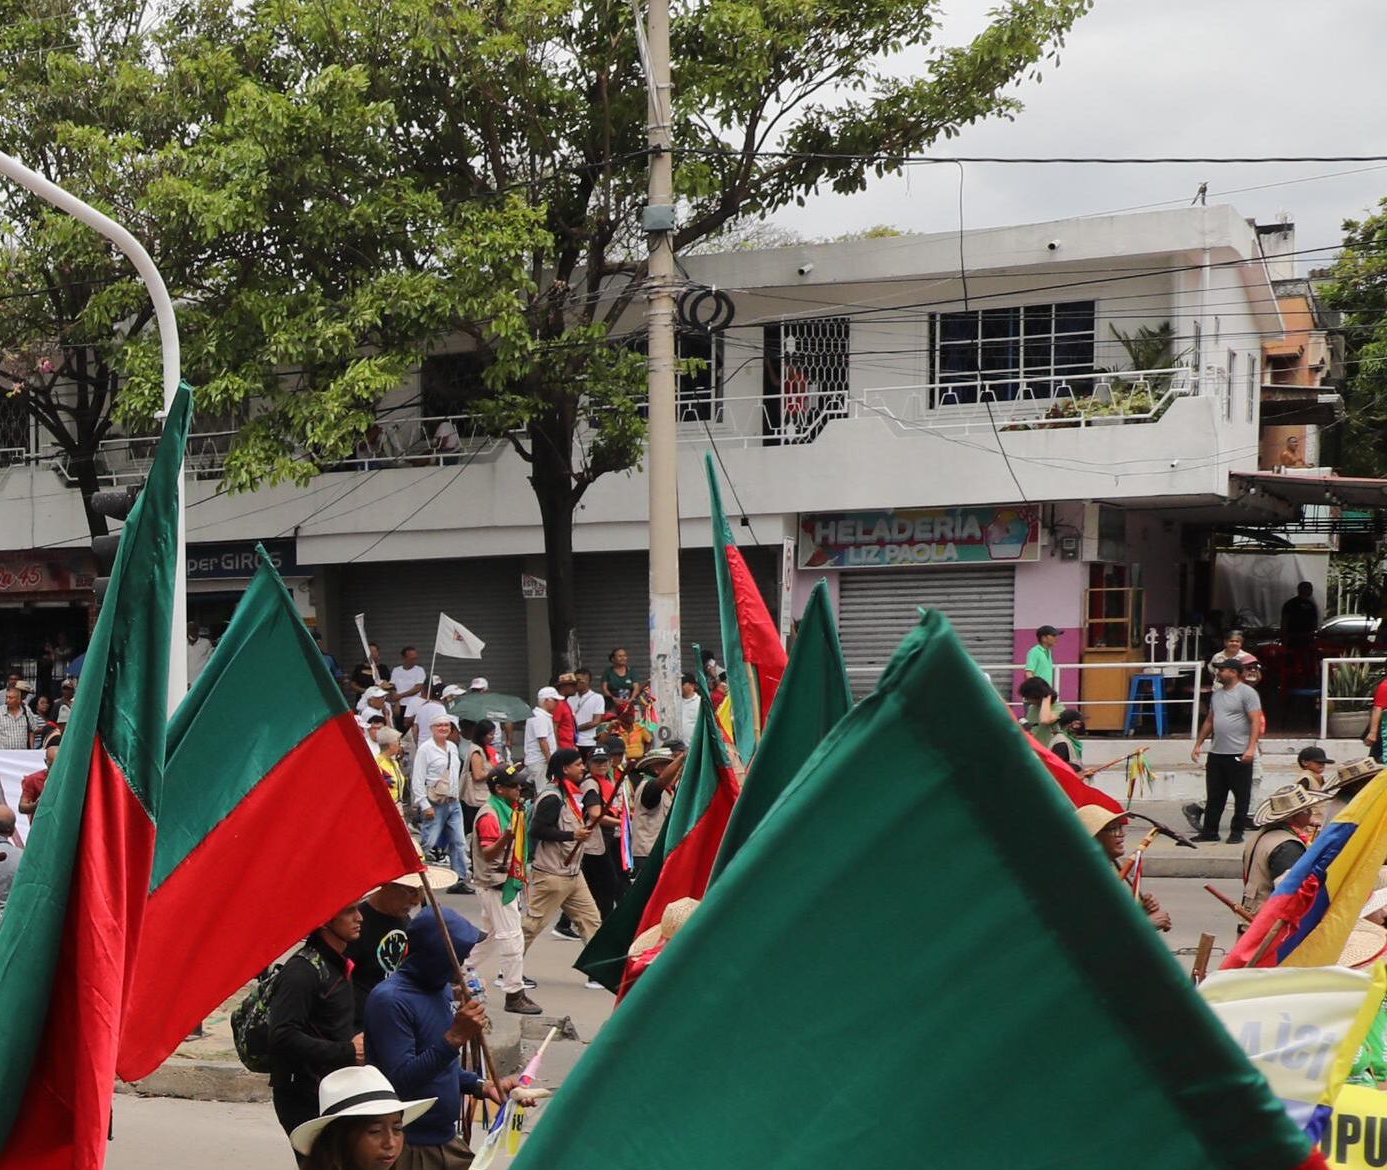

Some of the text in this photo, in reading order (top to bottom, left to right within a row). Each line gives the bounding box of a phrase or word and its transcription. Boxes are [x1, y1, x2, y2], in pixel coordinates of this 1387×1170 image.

[814, 510, 982, 545] HELADERÍA
[849, 542, 959, 565] LIZ PAOLA
